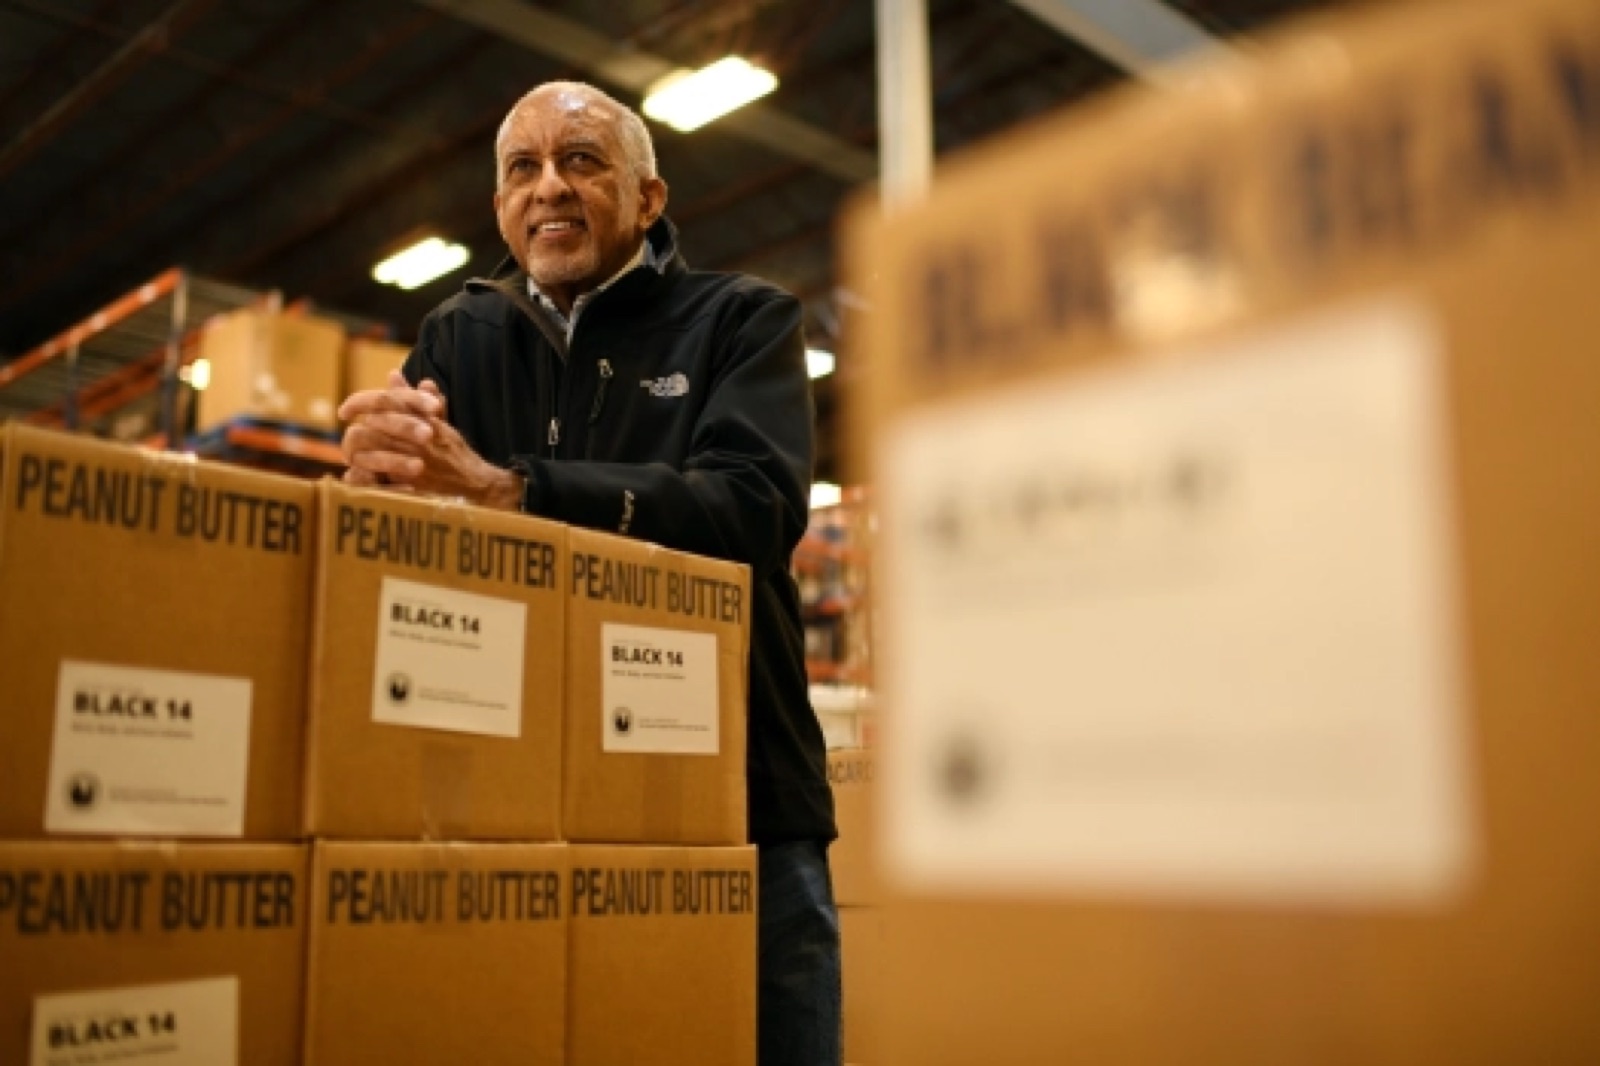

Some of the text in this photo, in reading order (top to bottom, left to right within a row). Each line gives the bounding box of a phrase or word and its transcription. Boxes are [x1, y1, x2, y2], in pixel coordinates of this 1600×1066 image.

[16, 454, 303, 555] PEANUT BUTTER
[336, 504, 556, 589] PEANUT BUTTER
[572, 551, 742, 624] PEANUT BUTTER
[389, 602, 481, 635] BLACK 14
[611, 645, 683, 668] BLACK 14
[73, 690, 193, 721] BLACK 14
[0, 869, 295, 934] PEANUT BUTTER
[327, 869, 560, 924] PEANUT BUTTER
[572, 868, 753, 917] PEANUT BUTTER
[48, 1010, 176, 1048] BLACK 14
